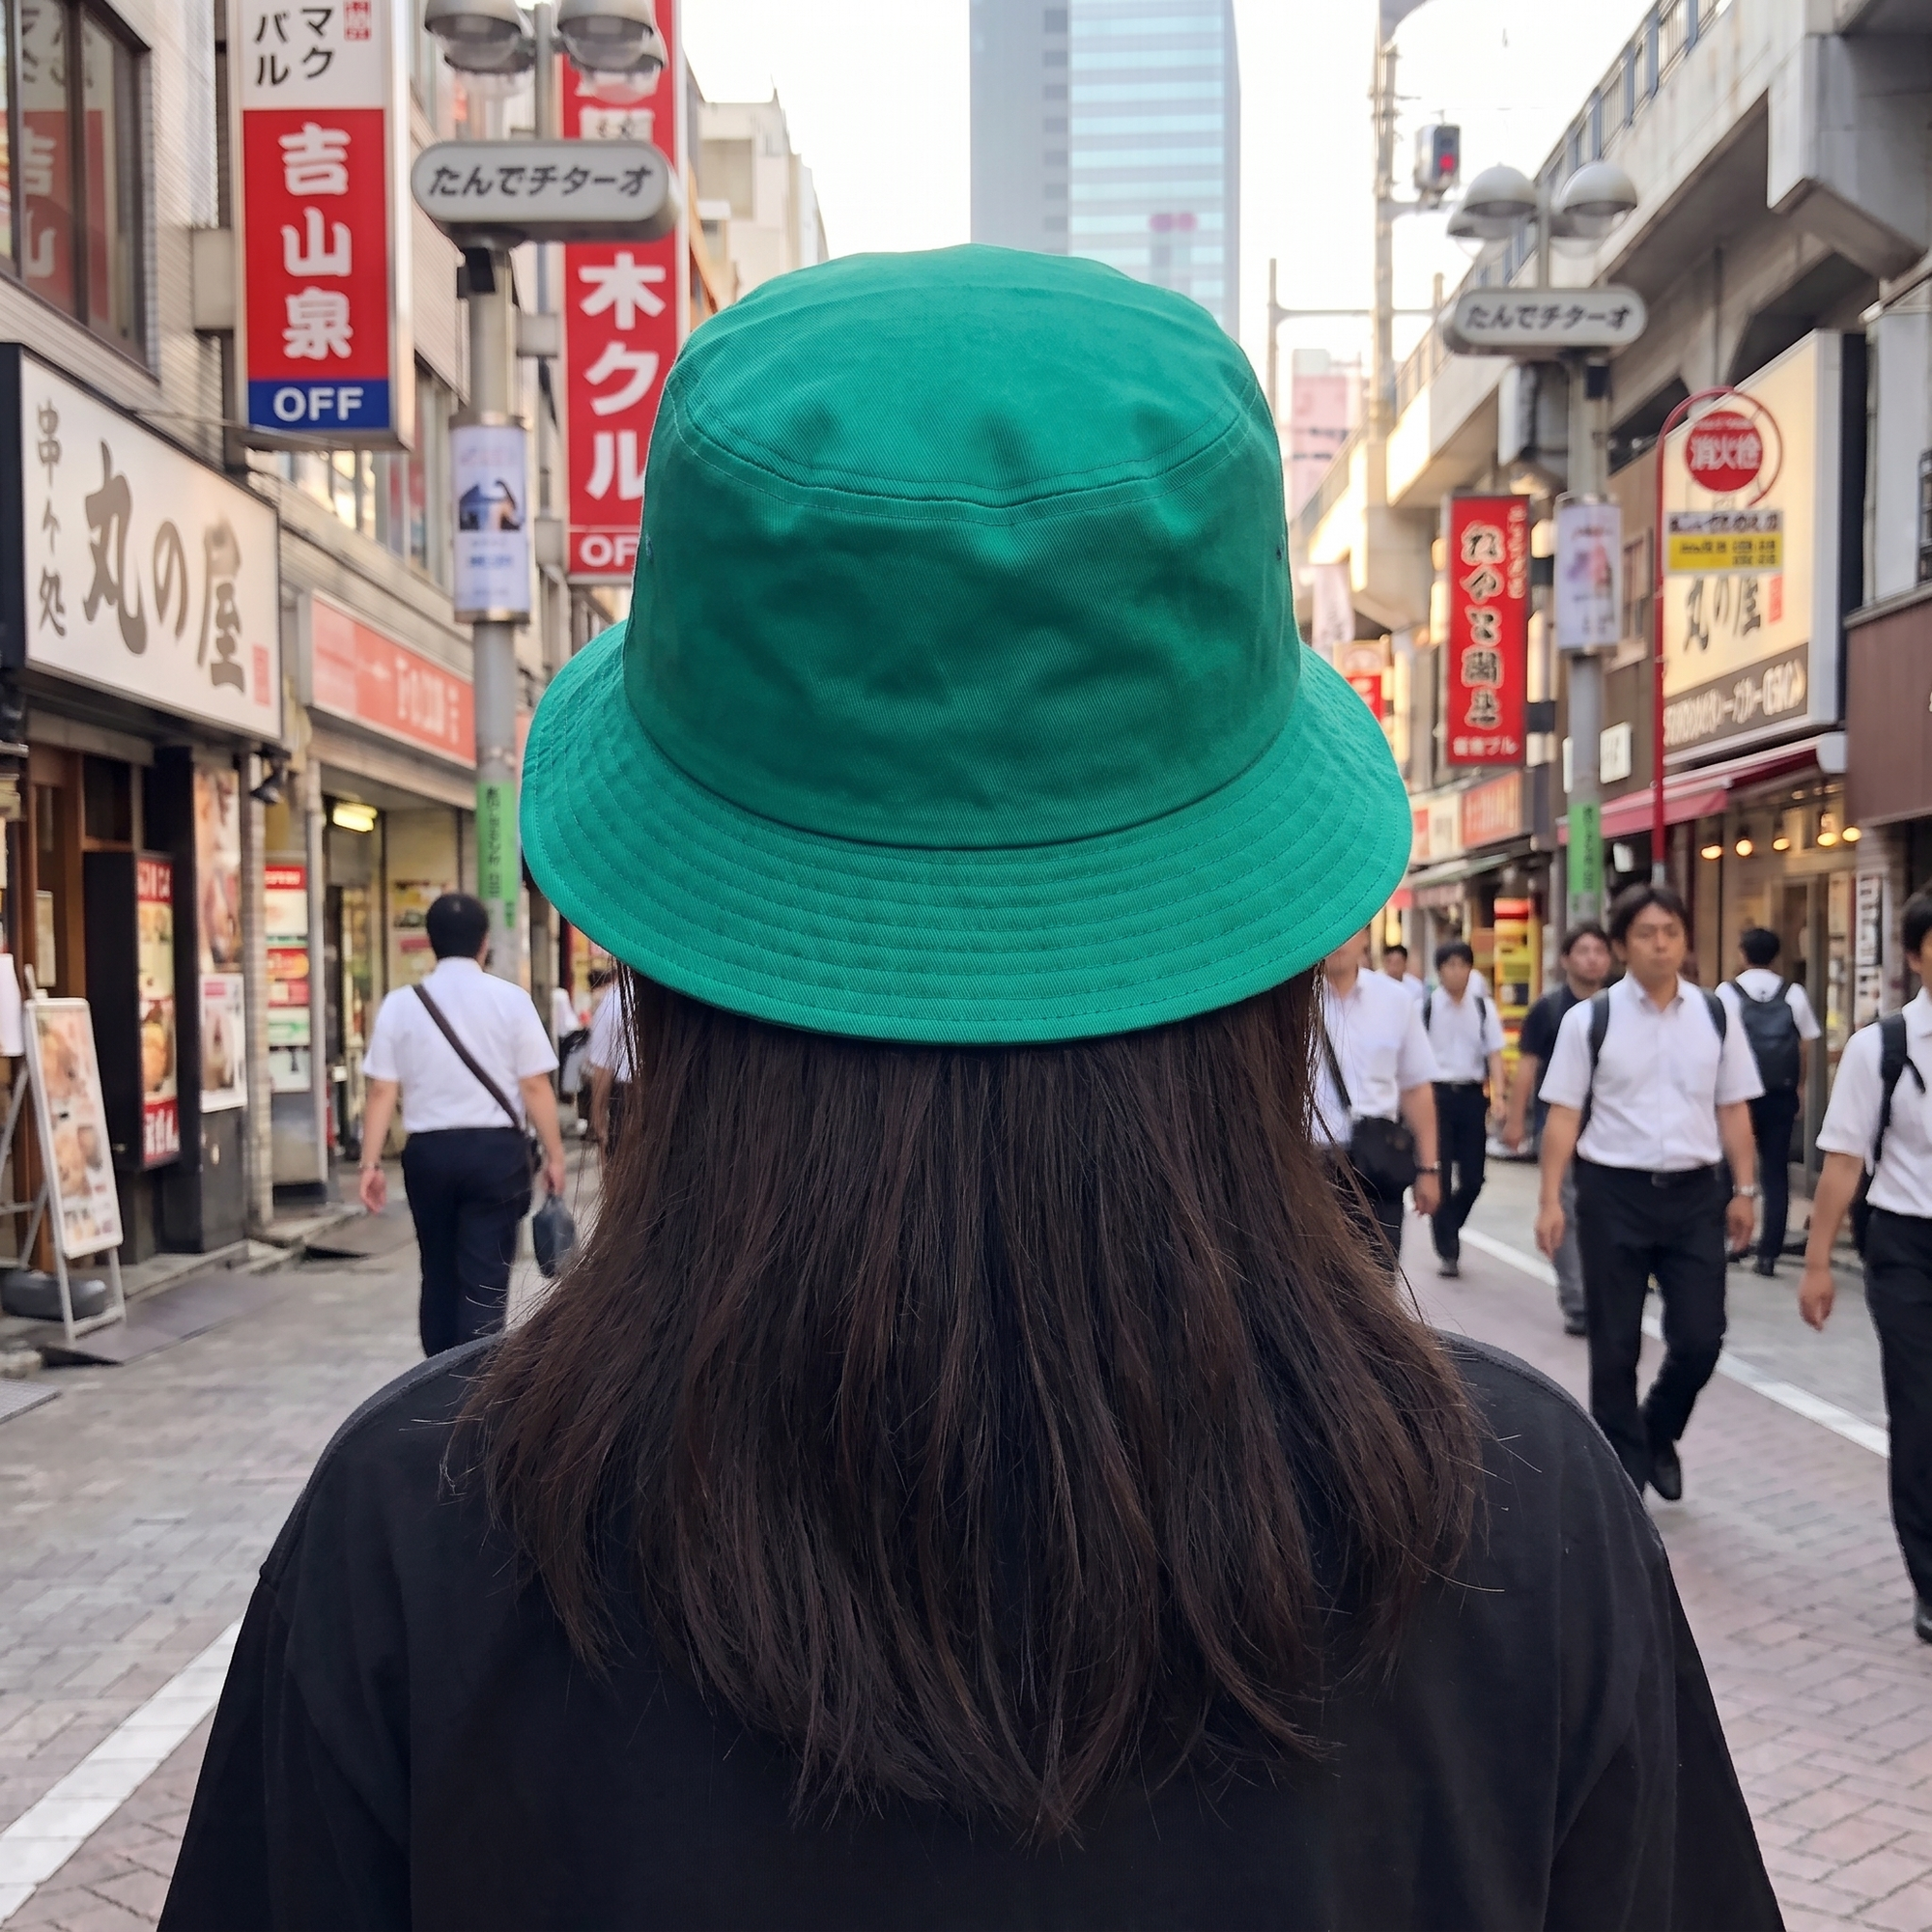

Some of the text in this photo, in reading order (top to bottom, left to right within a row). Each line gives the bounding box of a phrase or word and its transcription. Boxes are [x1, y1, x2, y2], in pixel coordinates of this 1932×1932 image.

[277, 122, 355, 361] 吉山泉
[272, 386, 365, 421] OFF
[580, 534, 639, 568] OF
